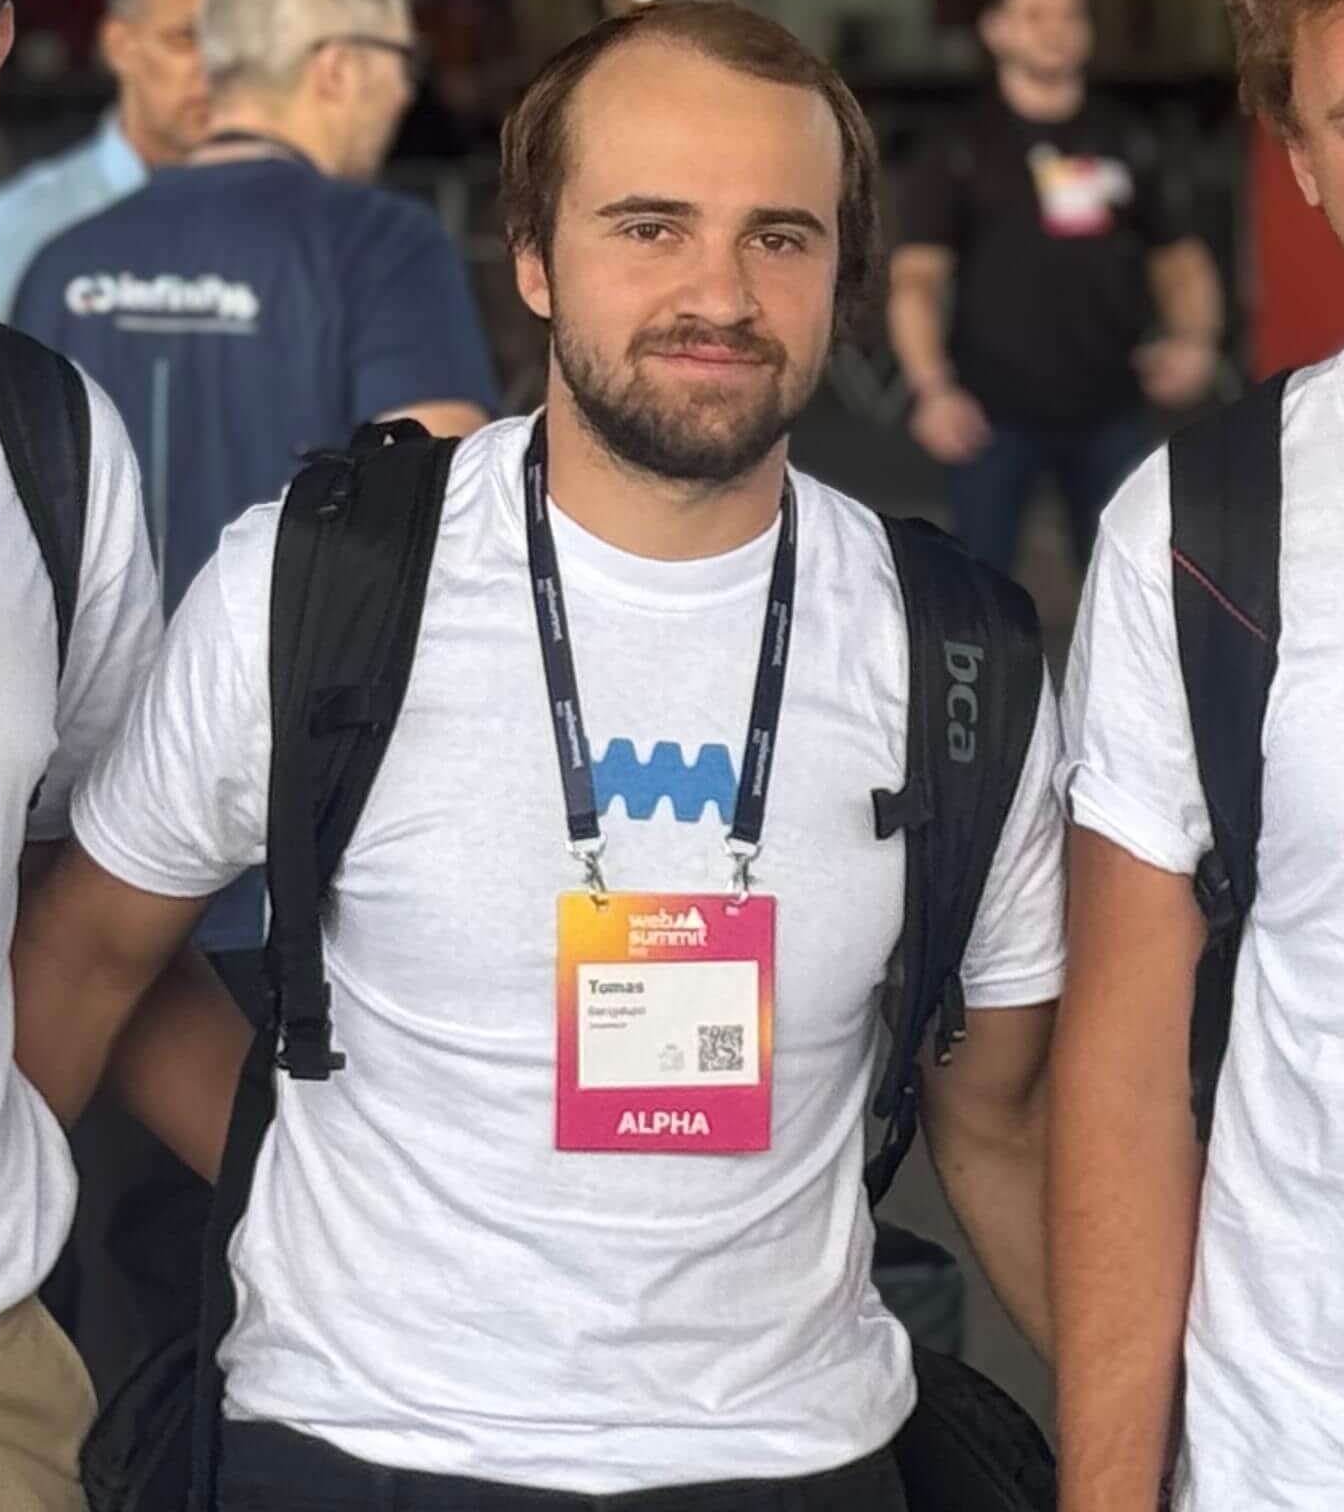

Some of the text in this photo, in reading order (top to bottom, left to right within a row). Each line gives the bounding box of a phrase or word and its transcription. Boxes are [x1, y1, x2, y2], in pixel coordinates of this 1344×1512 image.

[944, 640, 984, 764] bca
[628, 908, 673, 929] web
[628, 929, 708, 947] summit
[616, 1111, 710, 1136] ALPHA
